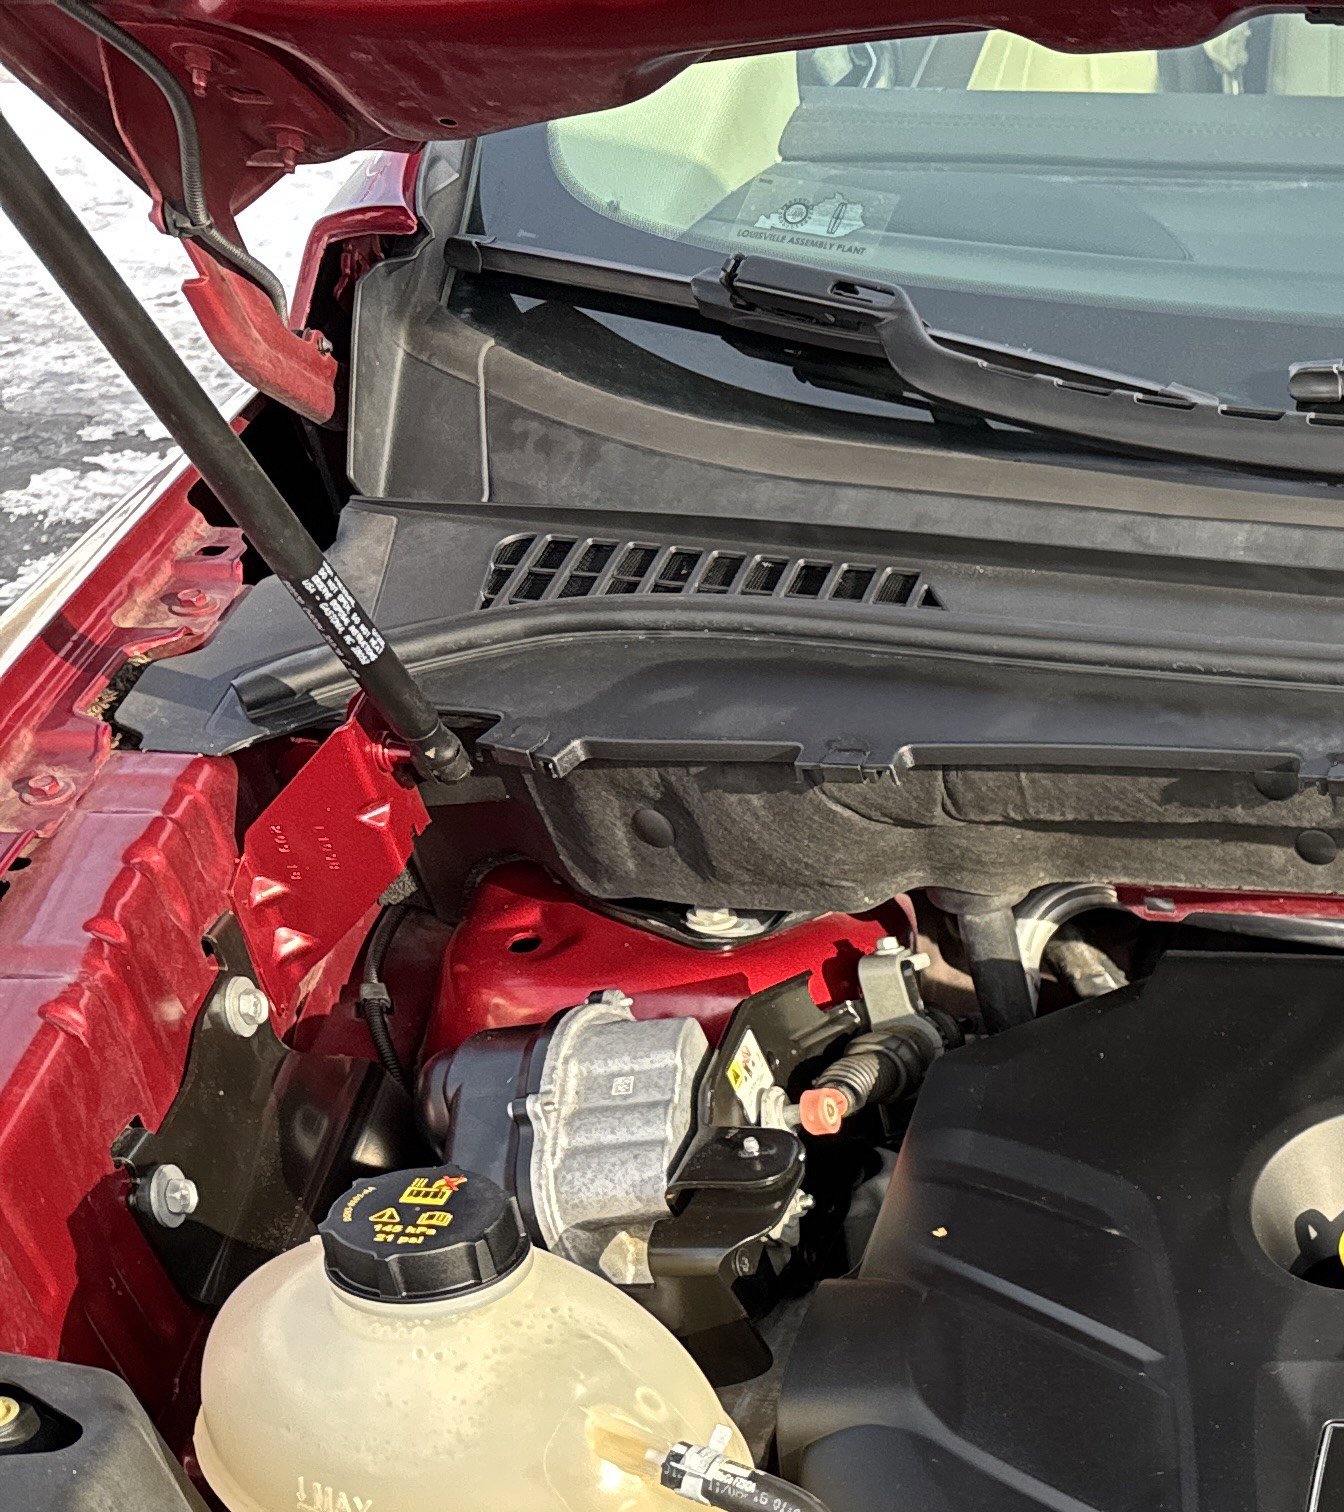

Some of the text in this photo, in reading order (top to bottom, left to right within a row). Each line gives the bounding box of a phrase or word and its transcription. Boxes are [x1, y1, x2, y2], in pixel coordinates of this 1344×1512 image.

[736, 228, 867, 256] LOUISVILLE ASSEMBLY PLANT
[302, 578, 317, 594] USA
[374, 1224, 437, 1236] 145 kPa
[373, 1233, 425, 1245] 21 psi
